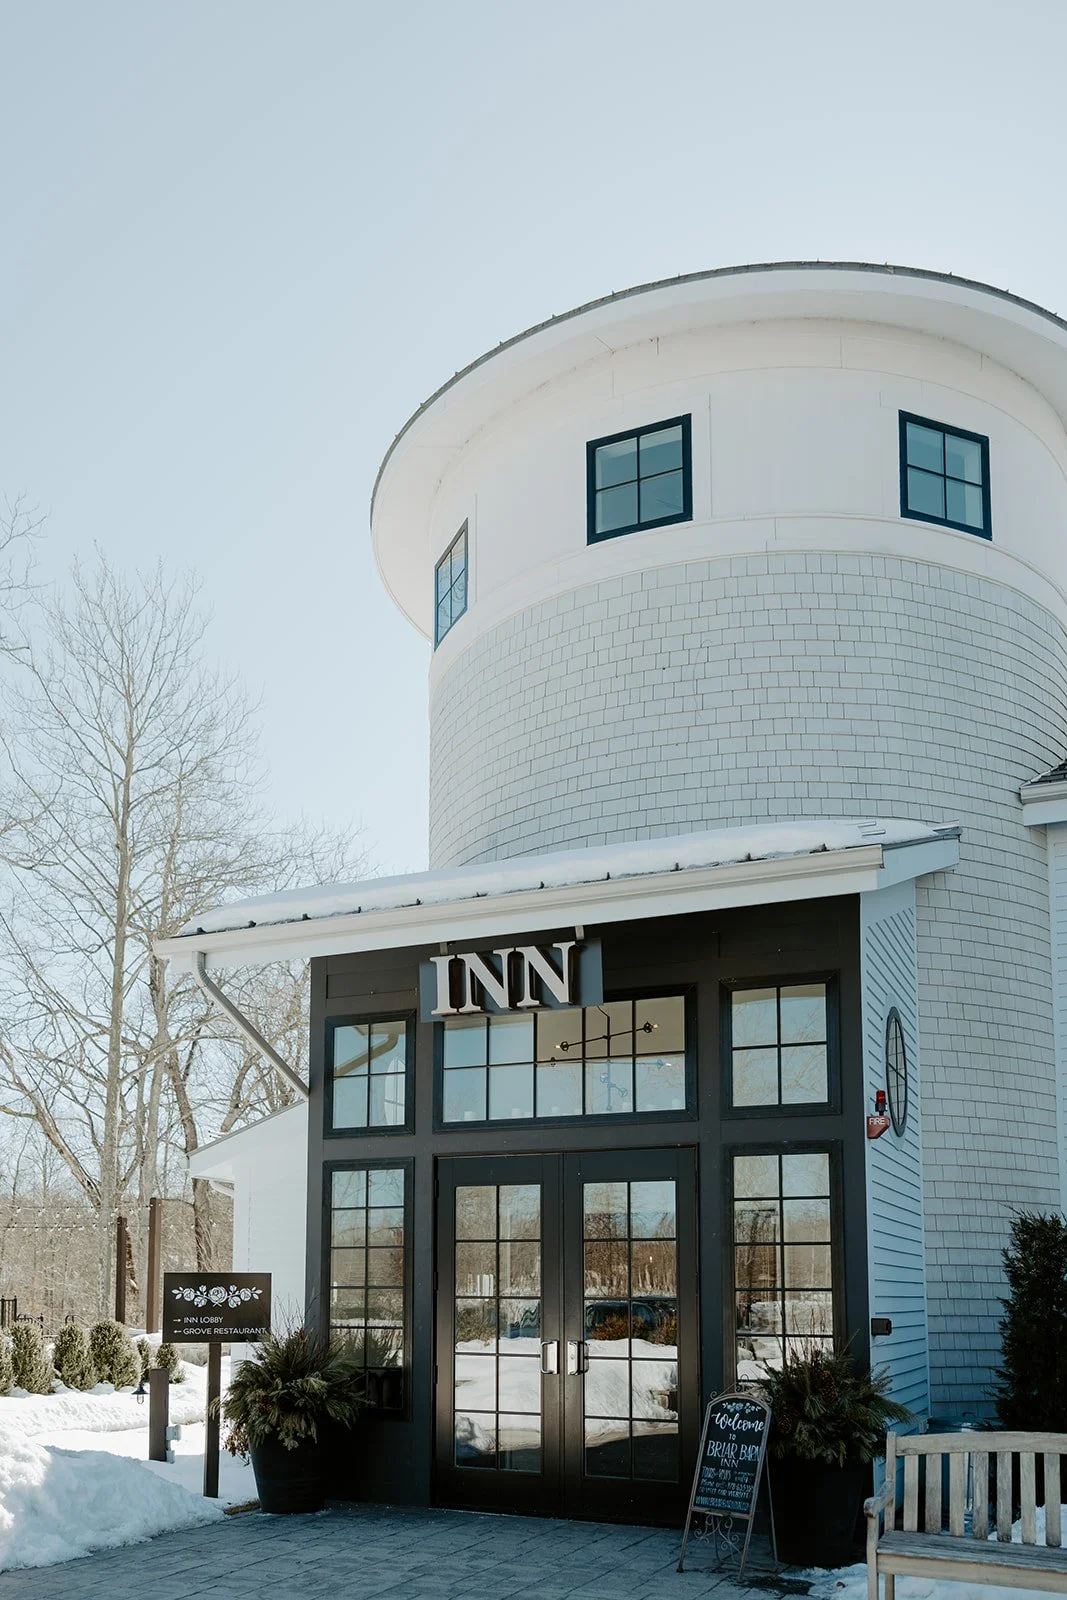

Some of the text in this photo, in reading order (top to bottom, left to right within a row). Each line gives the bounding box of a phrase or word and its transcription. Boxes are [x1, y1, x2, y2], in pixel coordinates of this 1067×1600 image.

[430, 941, 576, 1015] INN
[869, 1117, 885, 1125] FIRE
[183, 1327, 266, 1335] GROVE RESTAURANT
[711, 1412, 765, 1432] Welcome
[707, 1440, 760, 1461] BRIAR BARN
[720, 1458, 739, 1467] INN
